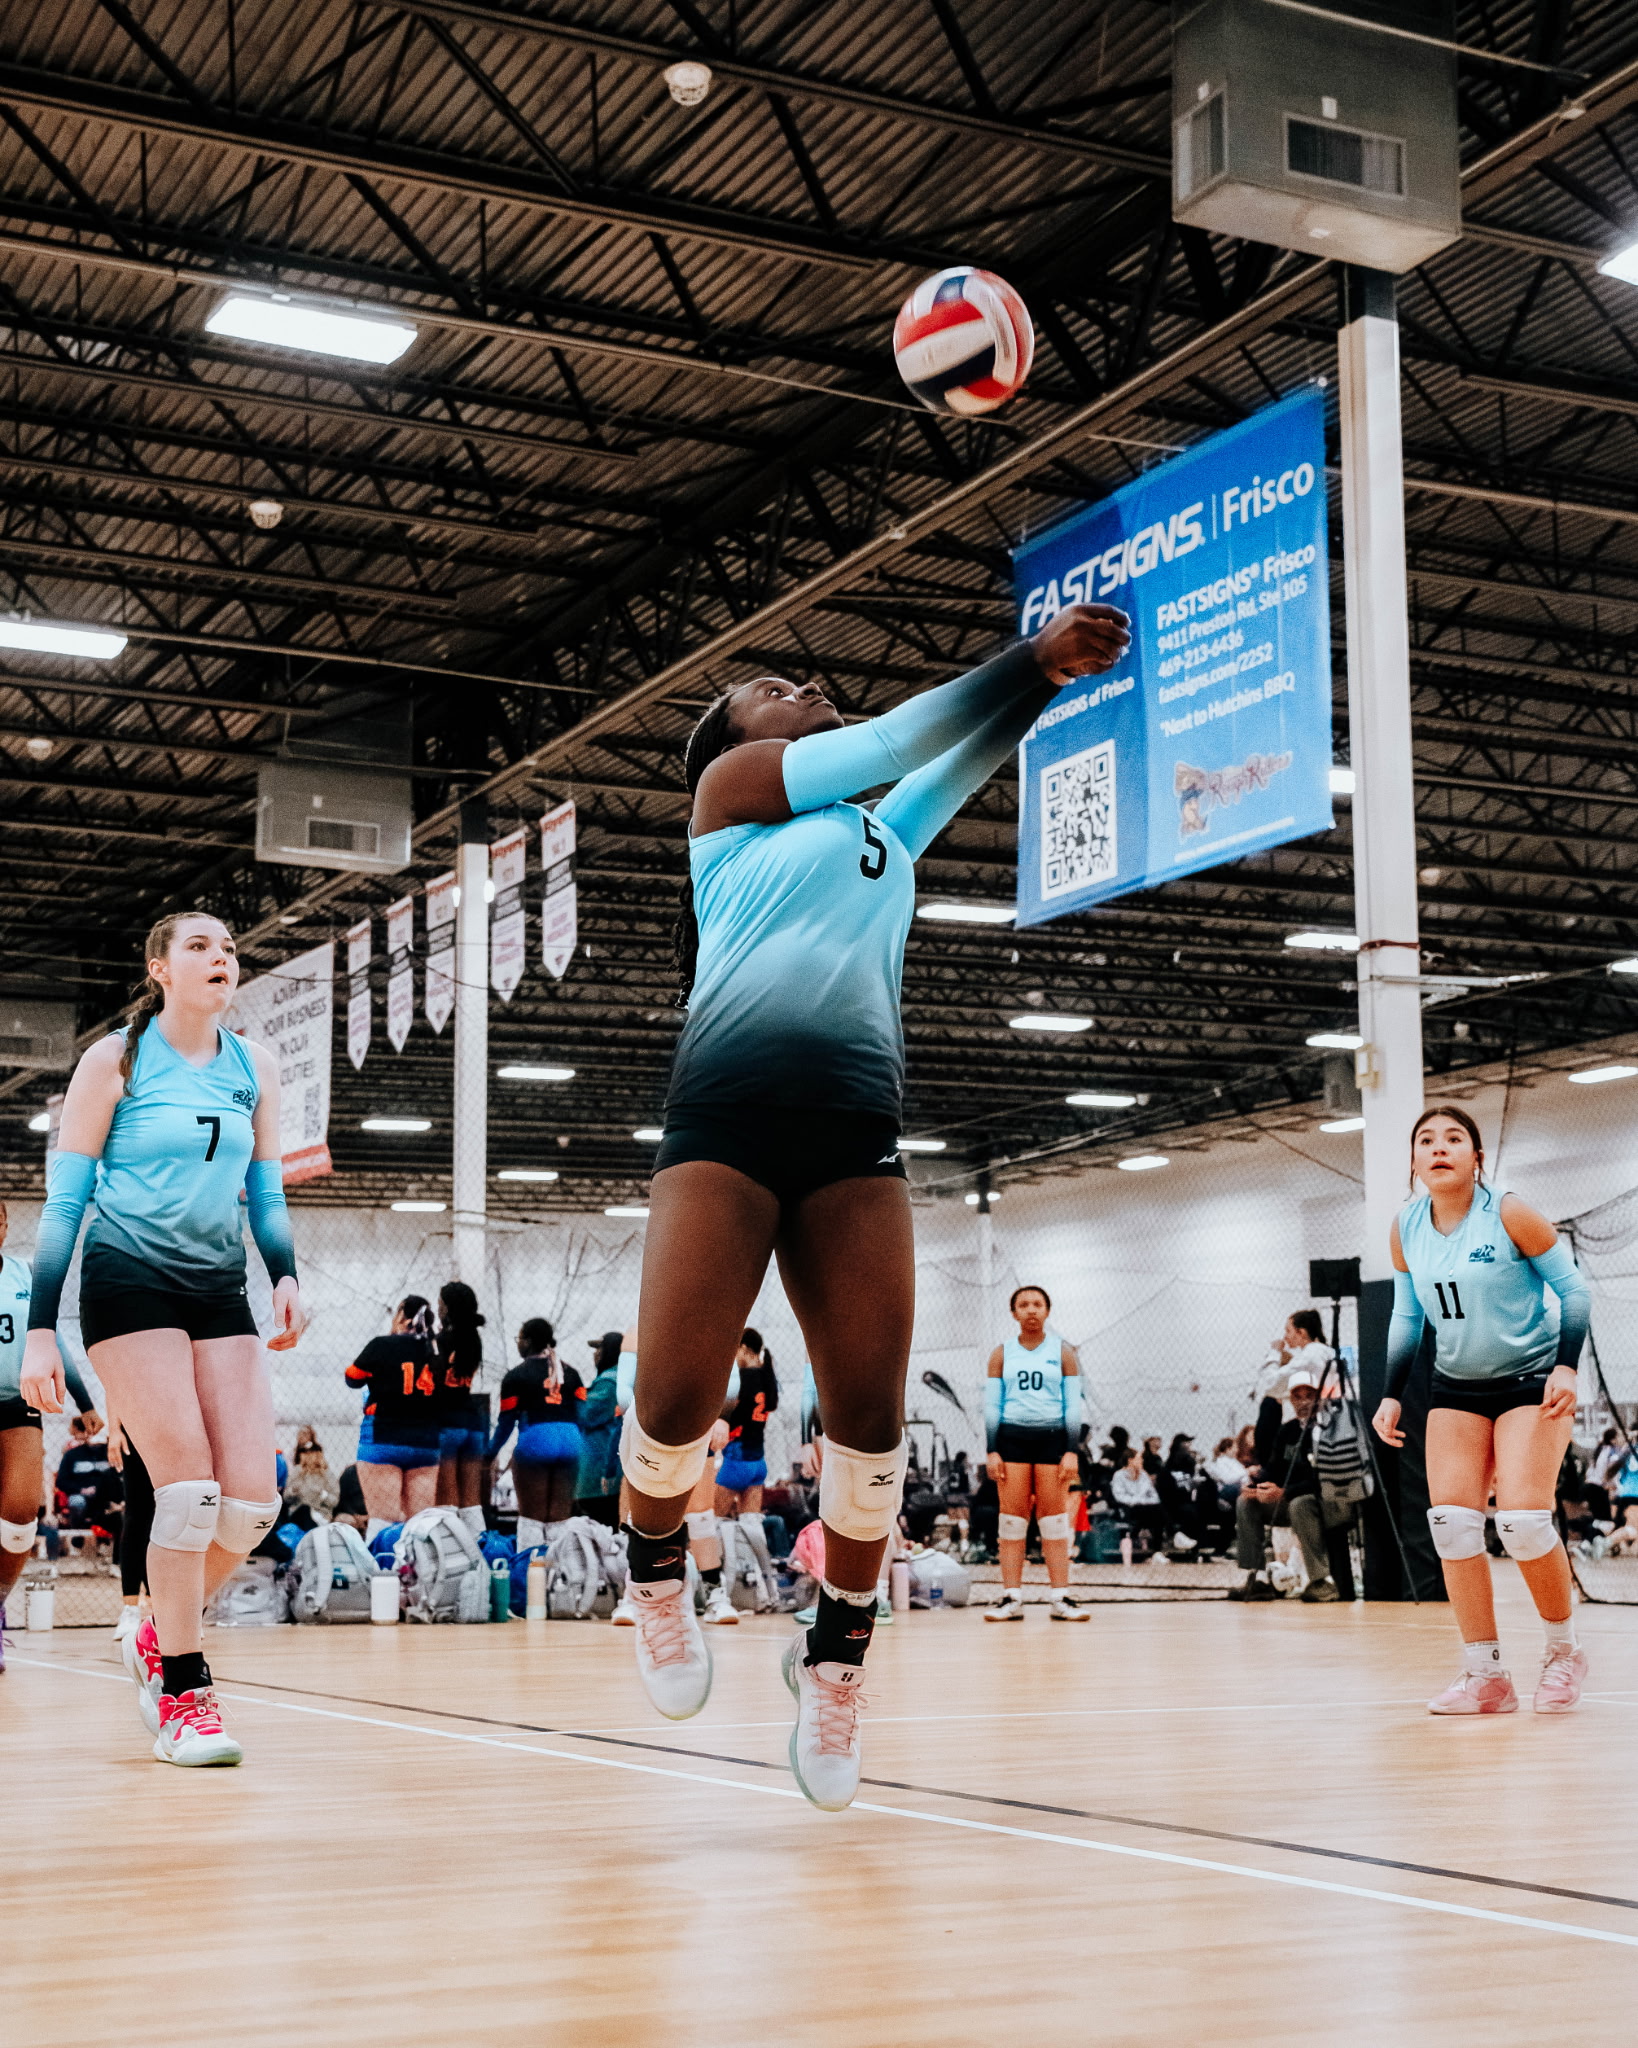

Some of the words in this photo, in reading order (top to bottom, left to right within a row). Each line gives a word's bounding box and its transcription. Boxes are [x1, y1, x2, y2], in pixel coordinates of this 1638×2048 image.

[1223, 462, 1315, 532] Frisco
[1263, 544, 1316, 583] Frisco
[1157, 627, 1188, 655] 9411
[1189, 609, 1236, 642] Preston
[1283, 573, 1308, 601] 105
[1194, 709, 1208, 726] to
[1208, 687, 1264, 721] Hutchins
[1264, 671, 1296, 699] BBQ
[860, 814, 887, 880] 5
[196, 1115, 221, 1162] 7
[1434, 1281, 1465, 1319] 11
[0, 1313, 15, 1344] 3
[401, 1361, 435, 1396] 14
[1017, 1370, 1043, 1391] 20
[751, 1392, 768, 1422] 2
